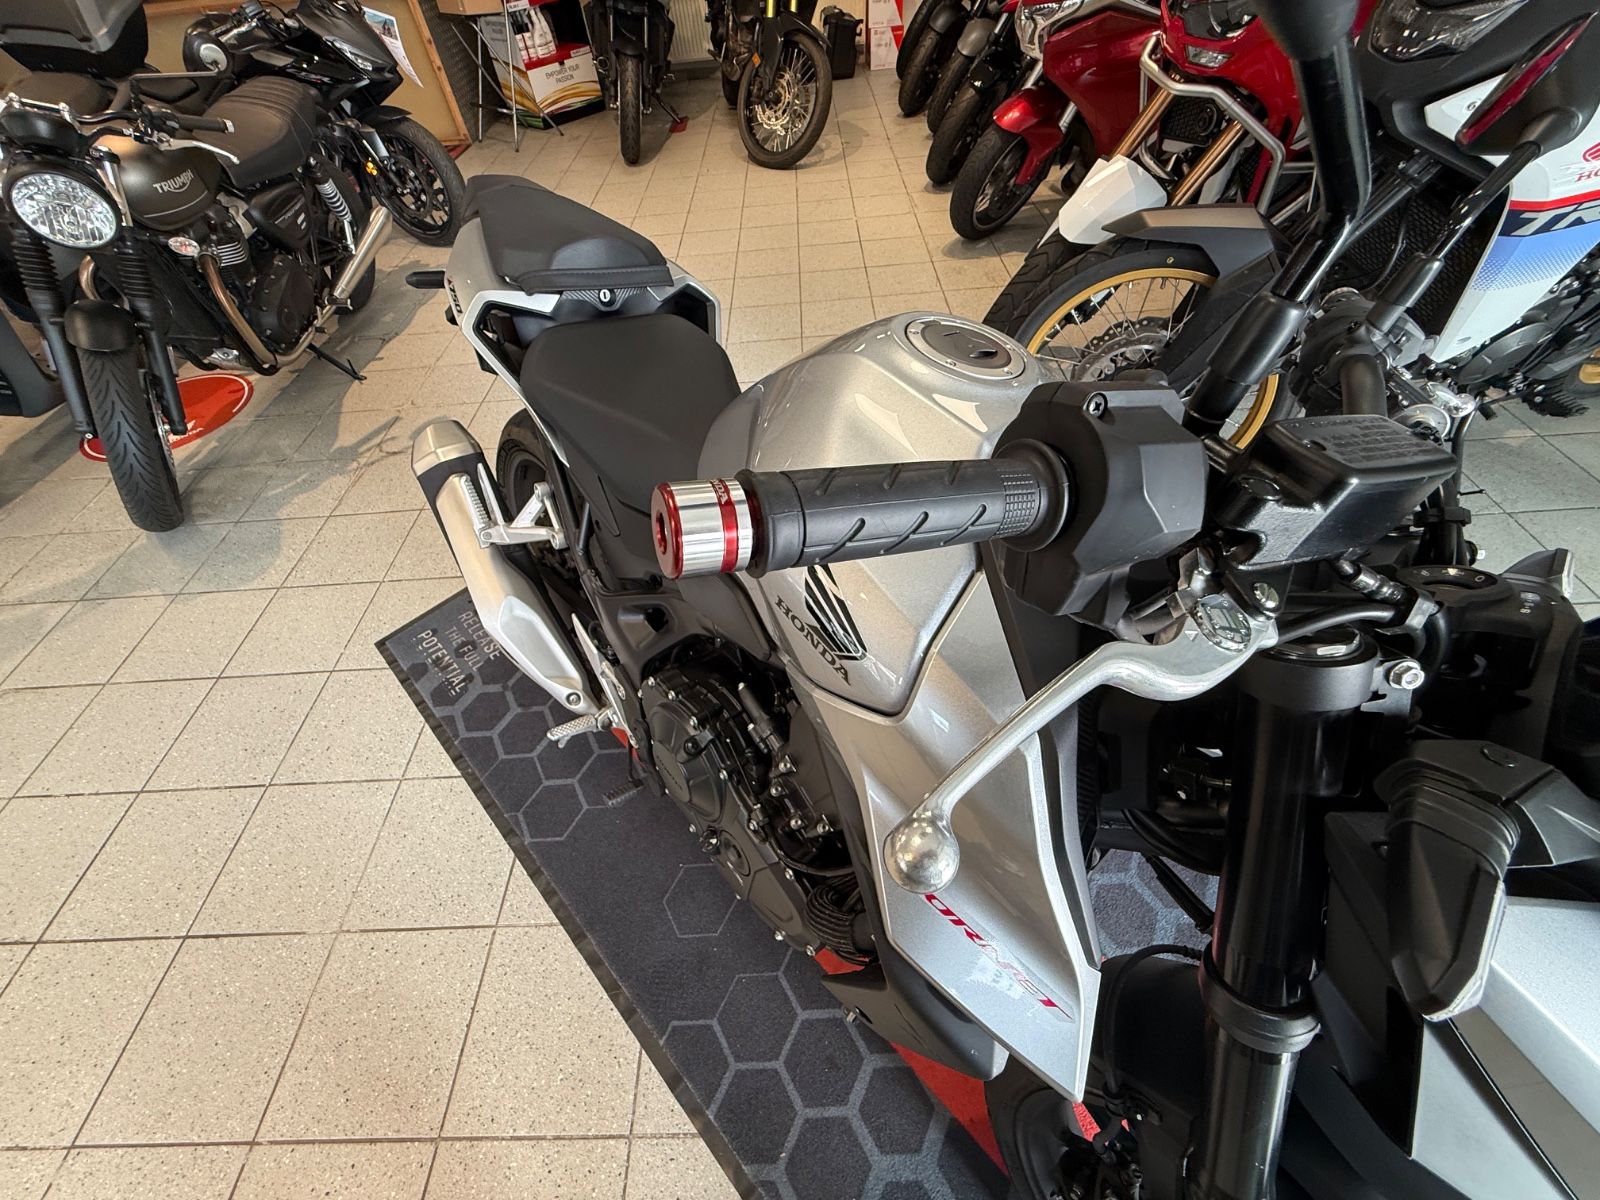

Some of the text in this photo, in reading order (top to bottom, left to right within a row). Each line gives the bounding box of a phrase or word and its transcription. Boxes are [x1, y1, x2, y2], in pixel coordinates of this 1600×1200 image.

[545, 67, 568, 80] EMPOWER
[555, 74, 575, 84] PASSION
[153, 169, 194, 194] TRIUMPH
[445, 626, 484, 672] THE FULL
[458, 611, 500, 660] RELEASE
[775, 594, 851, 686] HONDA
[417, 630, 466, 693] POTENTIAL
[924, 893, 1074, 1020] ORNET
